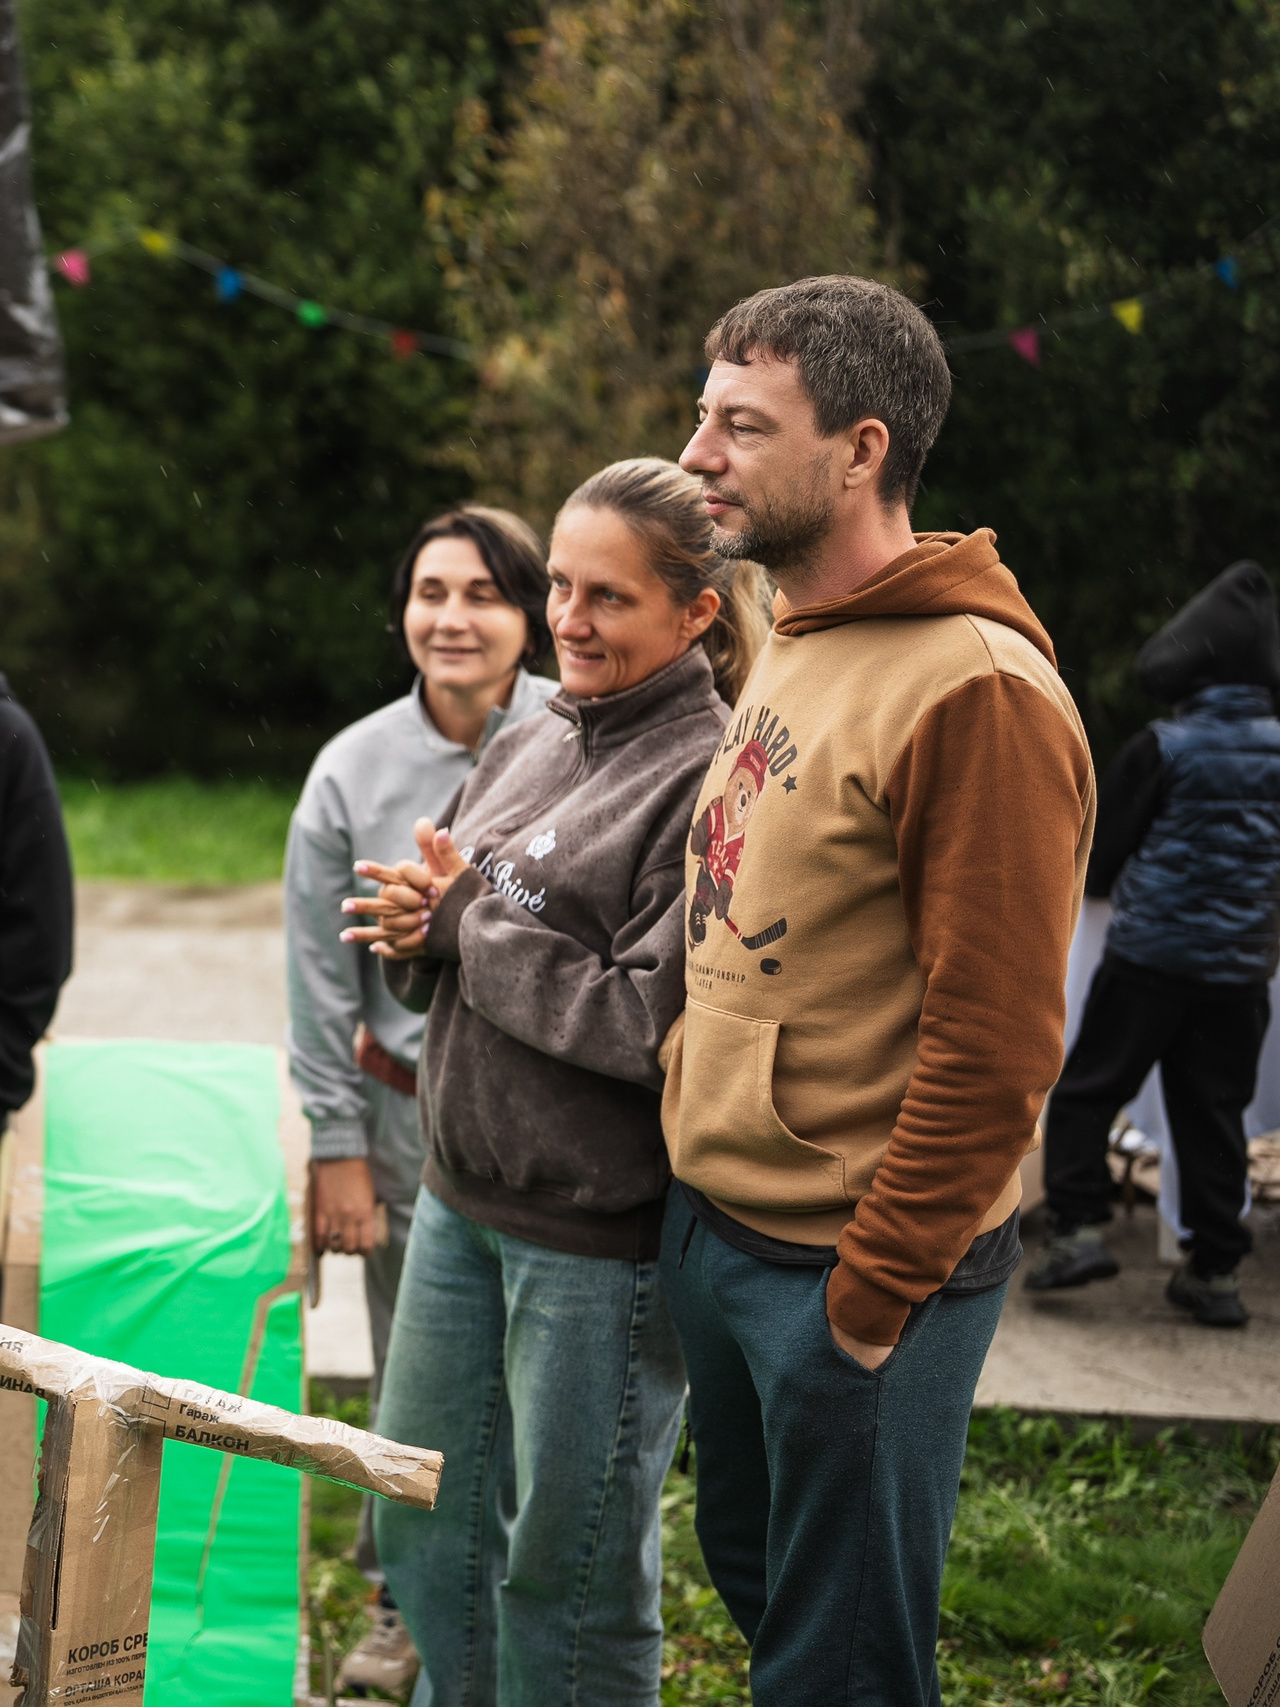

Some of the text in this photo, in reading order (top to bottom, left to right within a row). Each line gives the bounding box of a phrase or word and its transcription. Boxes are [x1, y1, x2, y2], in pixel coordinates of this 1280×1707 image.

[751, 705, 798, 777] HARD
[179, 1403, 220, 1424] Гараж
[175, 1424, 250, 1451] БАЛКОН
[67, 1638, 120, 1664] КОРОБ
[1247, 1651, 1276, 1707] КОРОБ
